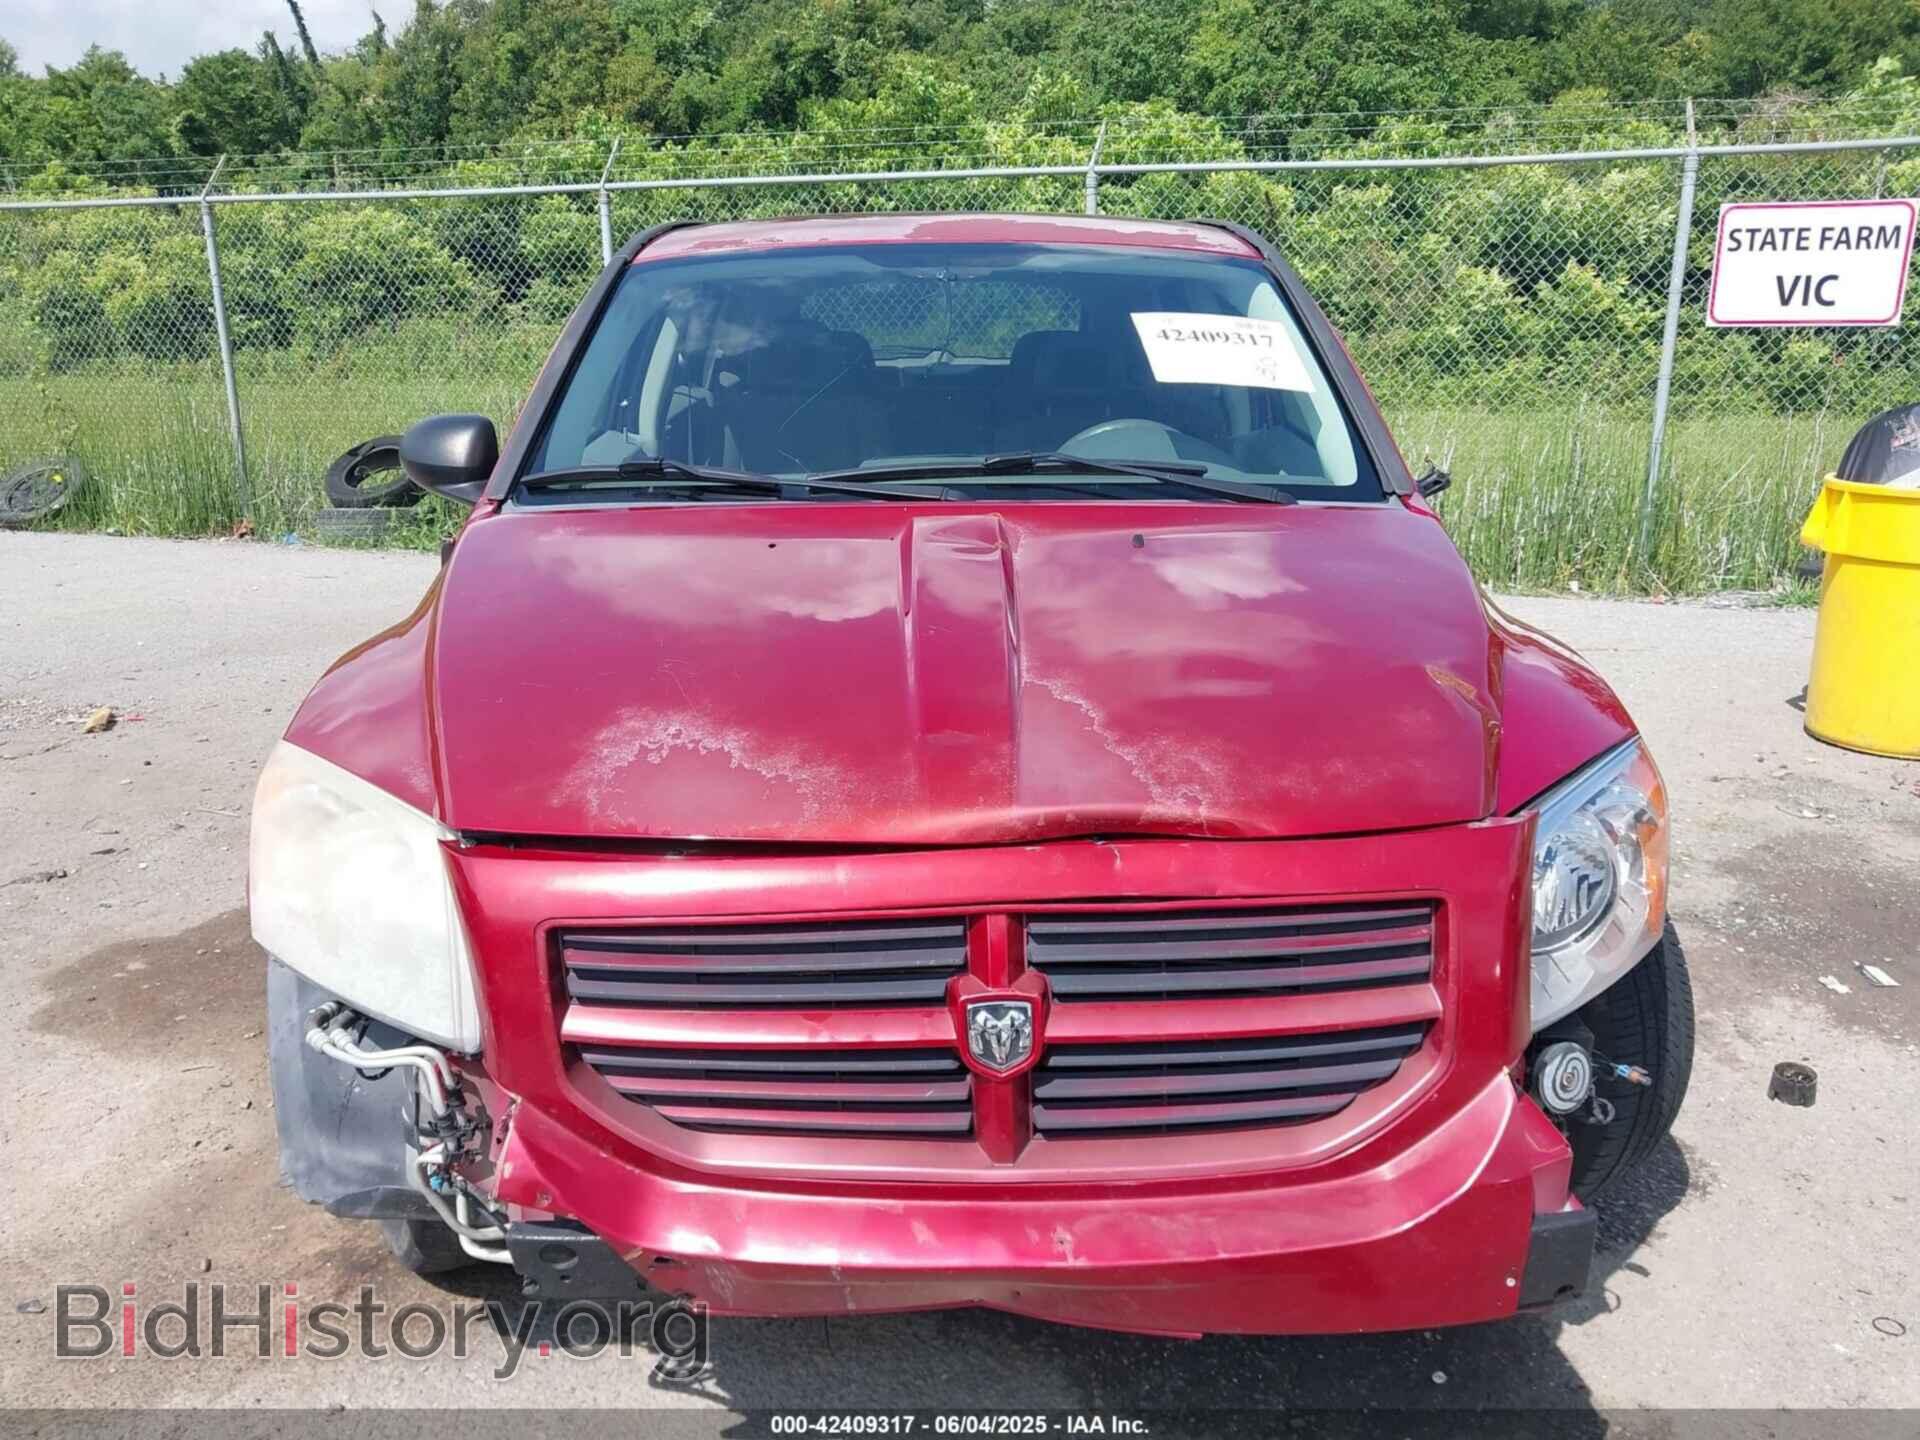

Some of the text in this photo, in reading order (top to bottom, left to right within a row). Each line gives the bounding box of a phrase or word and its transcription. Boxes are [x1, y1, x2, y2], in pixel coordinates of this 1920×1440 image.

[1727, 225, 1902, 252] STATE FARM
[1776, 274, 1839, 306] VIC
[1156, 328, 1273, 348] 42409317
